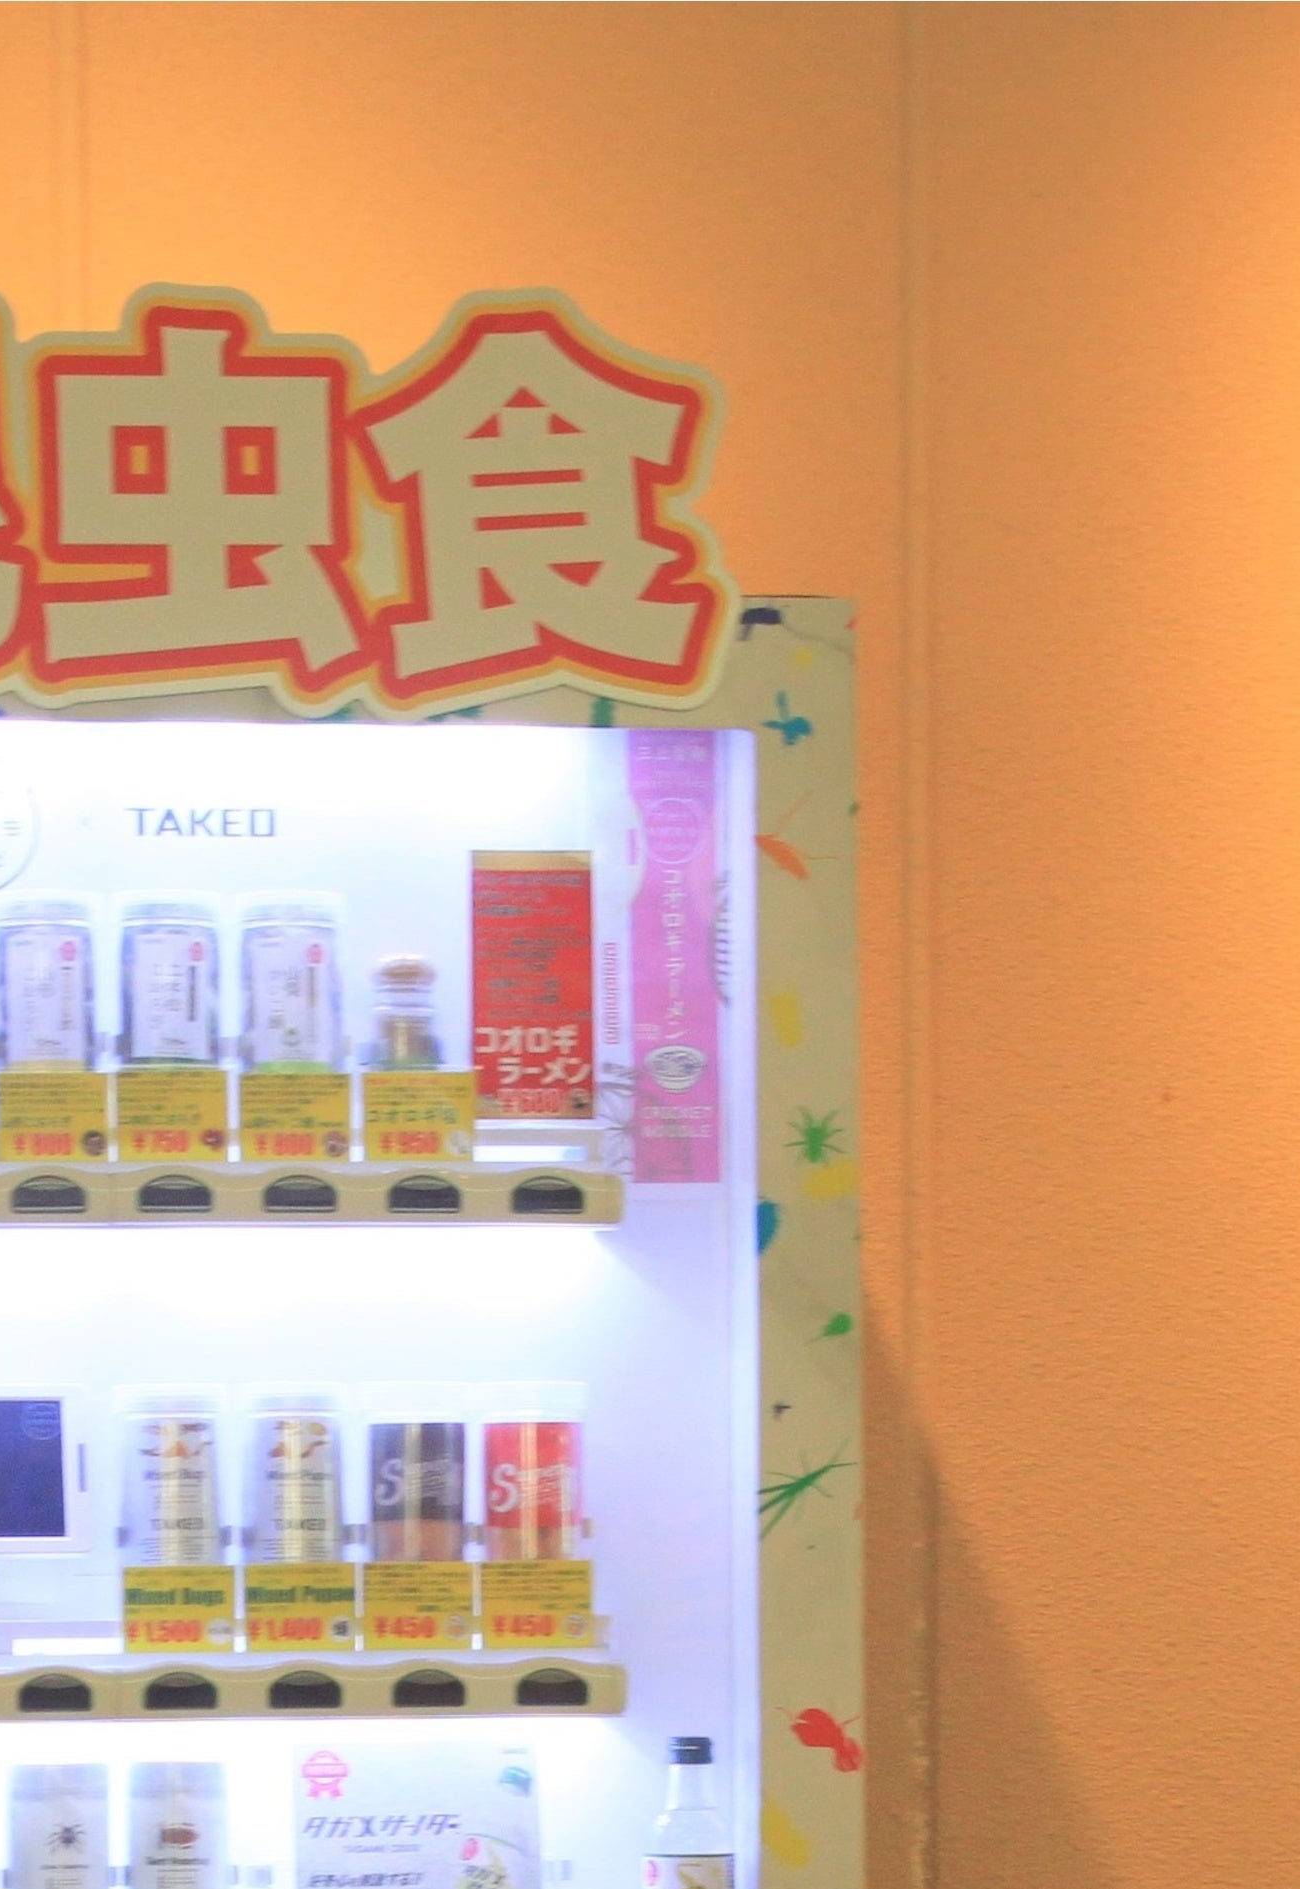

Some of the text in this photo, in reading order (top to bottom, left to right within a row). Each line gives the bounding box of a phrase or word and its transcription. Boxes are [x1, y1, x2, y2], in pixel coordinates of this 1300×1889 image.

[125, 807, 276, 838] TAKEO
[475, 1026, 580, 1054] コオロギ
[497, 1057, 591, 1085] ラーメン
